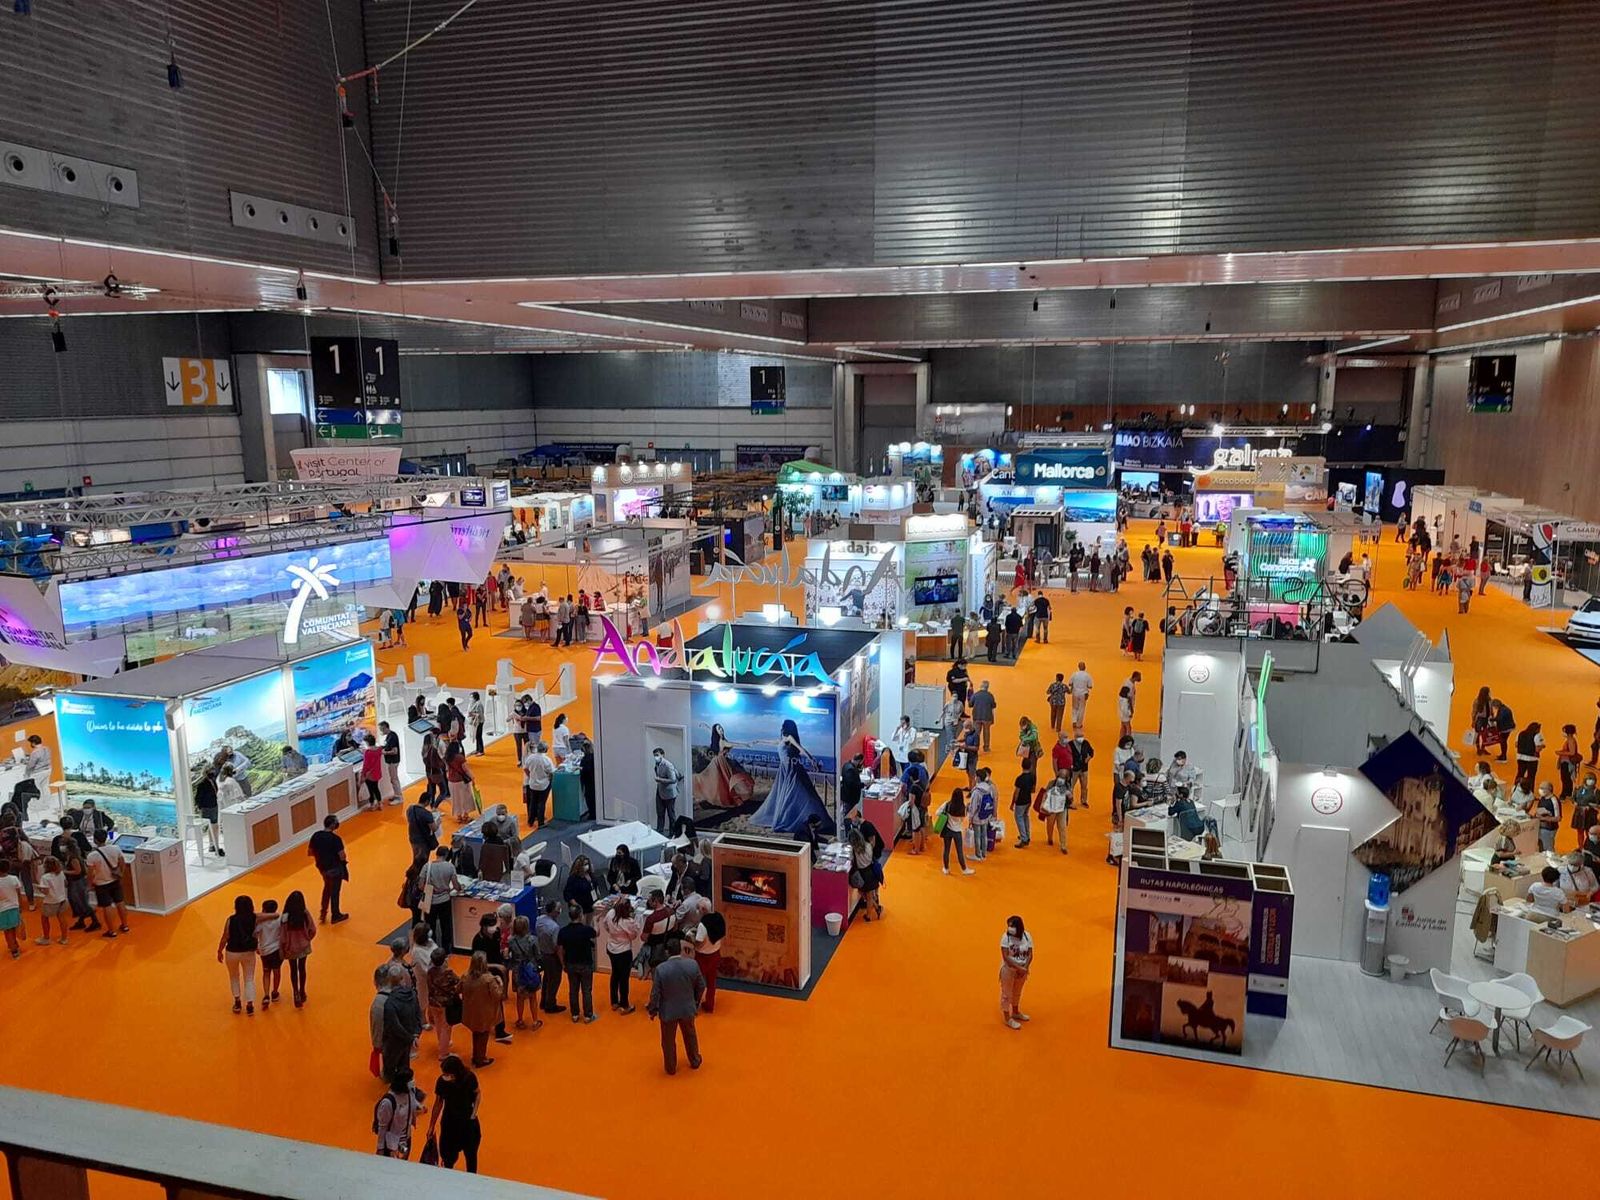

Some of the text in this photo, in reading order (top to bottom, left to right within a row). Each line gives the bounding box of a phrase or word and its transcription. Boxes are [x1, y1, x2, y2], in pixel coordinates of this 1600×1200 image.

[329, 344, 340, 375] 1
[375, 346, 385, 376] 1
[1492, 358, 1500, 377] 1
[188, 359, 209, 405] 3
[759, 369, 766, 385] 1
[1142, 434, 1184, 449] BIZKAIA
[304, 457, 326, 469] visit
[328, 456, 371, 467] Center
[1033, 462, 1095, 479] Mallorca
[301, 619, 352, 636] VALENCIANA
[302, 611, 351, 628] COMUNITAT
[1, 624, 58, 642] COMUNITAT
[6, 633, 69, 652] VALENCIANA
[588, 613, 840, 688] Andalucía
[1140, 877, 1164, 888] RUTAS
